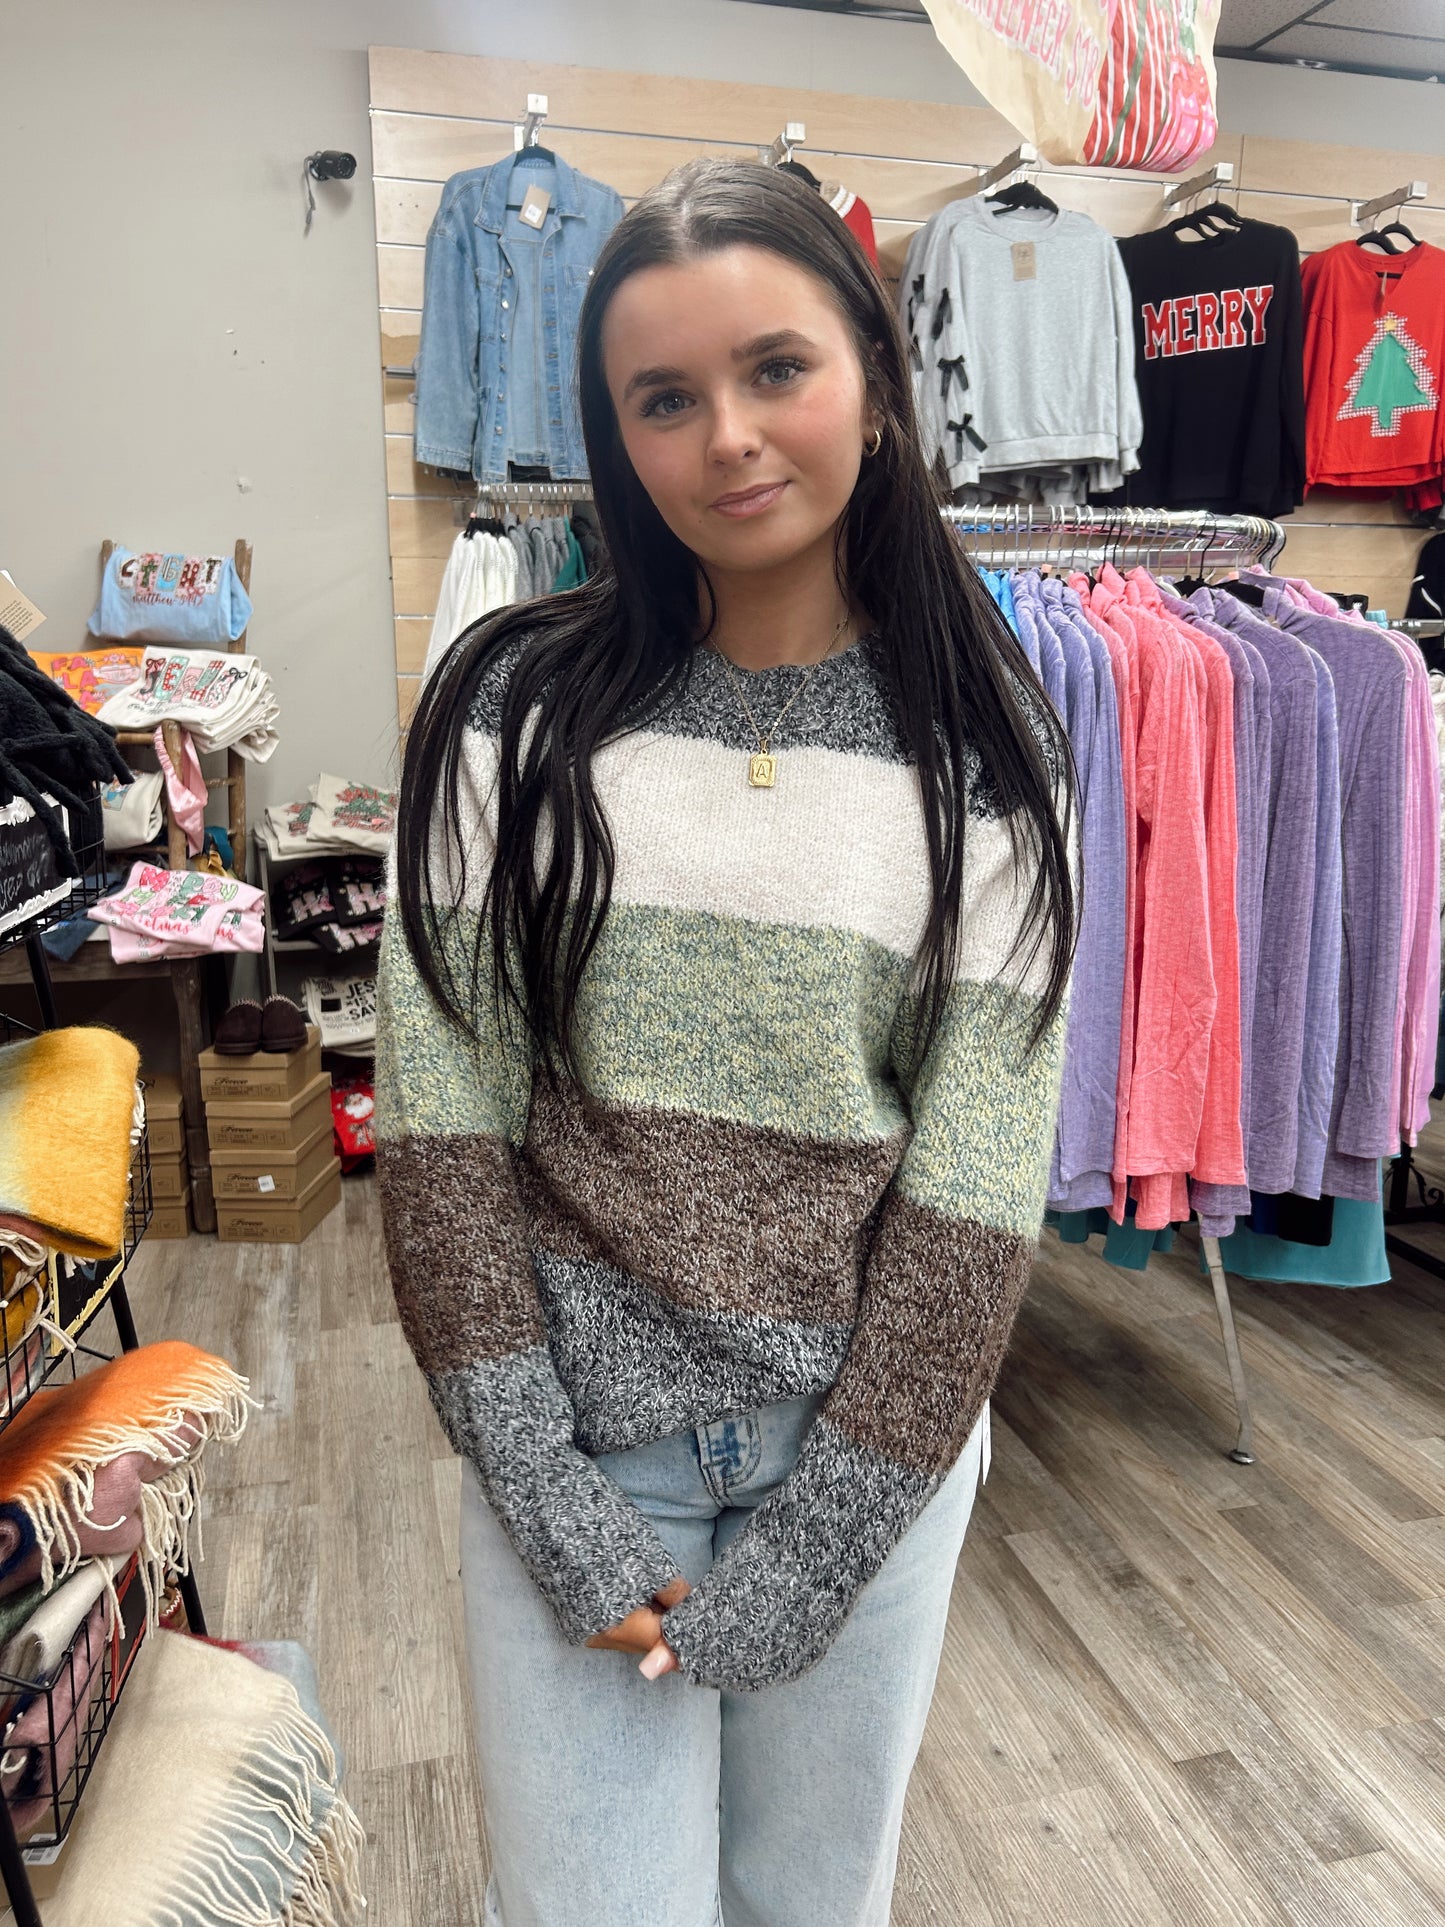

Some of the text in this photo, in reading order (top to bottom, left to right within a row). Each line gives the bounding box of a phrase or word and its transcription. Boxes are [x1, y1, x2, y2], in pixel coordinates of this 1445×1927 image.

[1142, 285, 1274, 360] MERRY
[53, 656, 88, 671] FA
[62, 670, 98, 690] LA
[756, 763, 767, 778] A
[346, 979, 377, 999] JES
